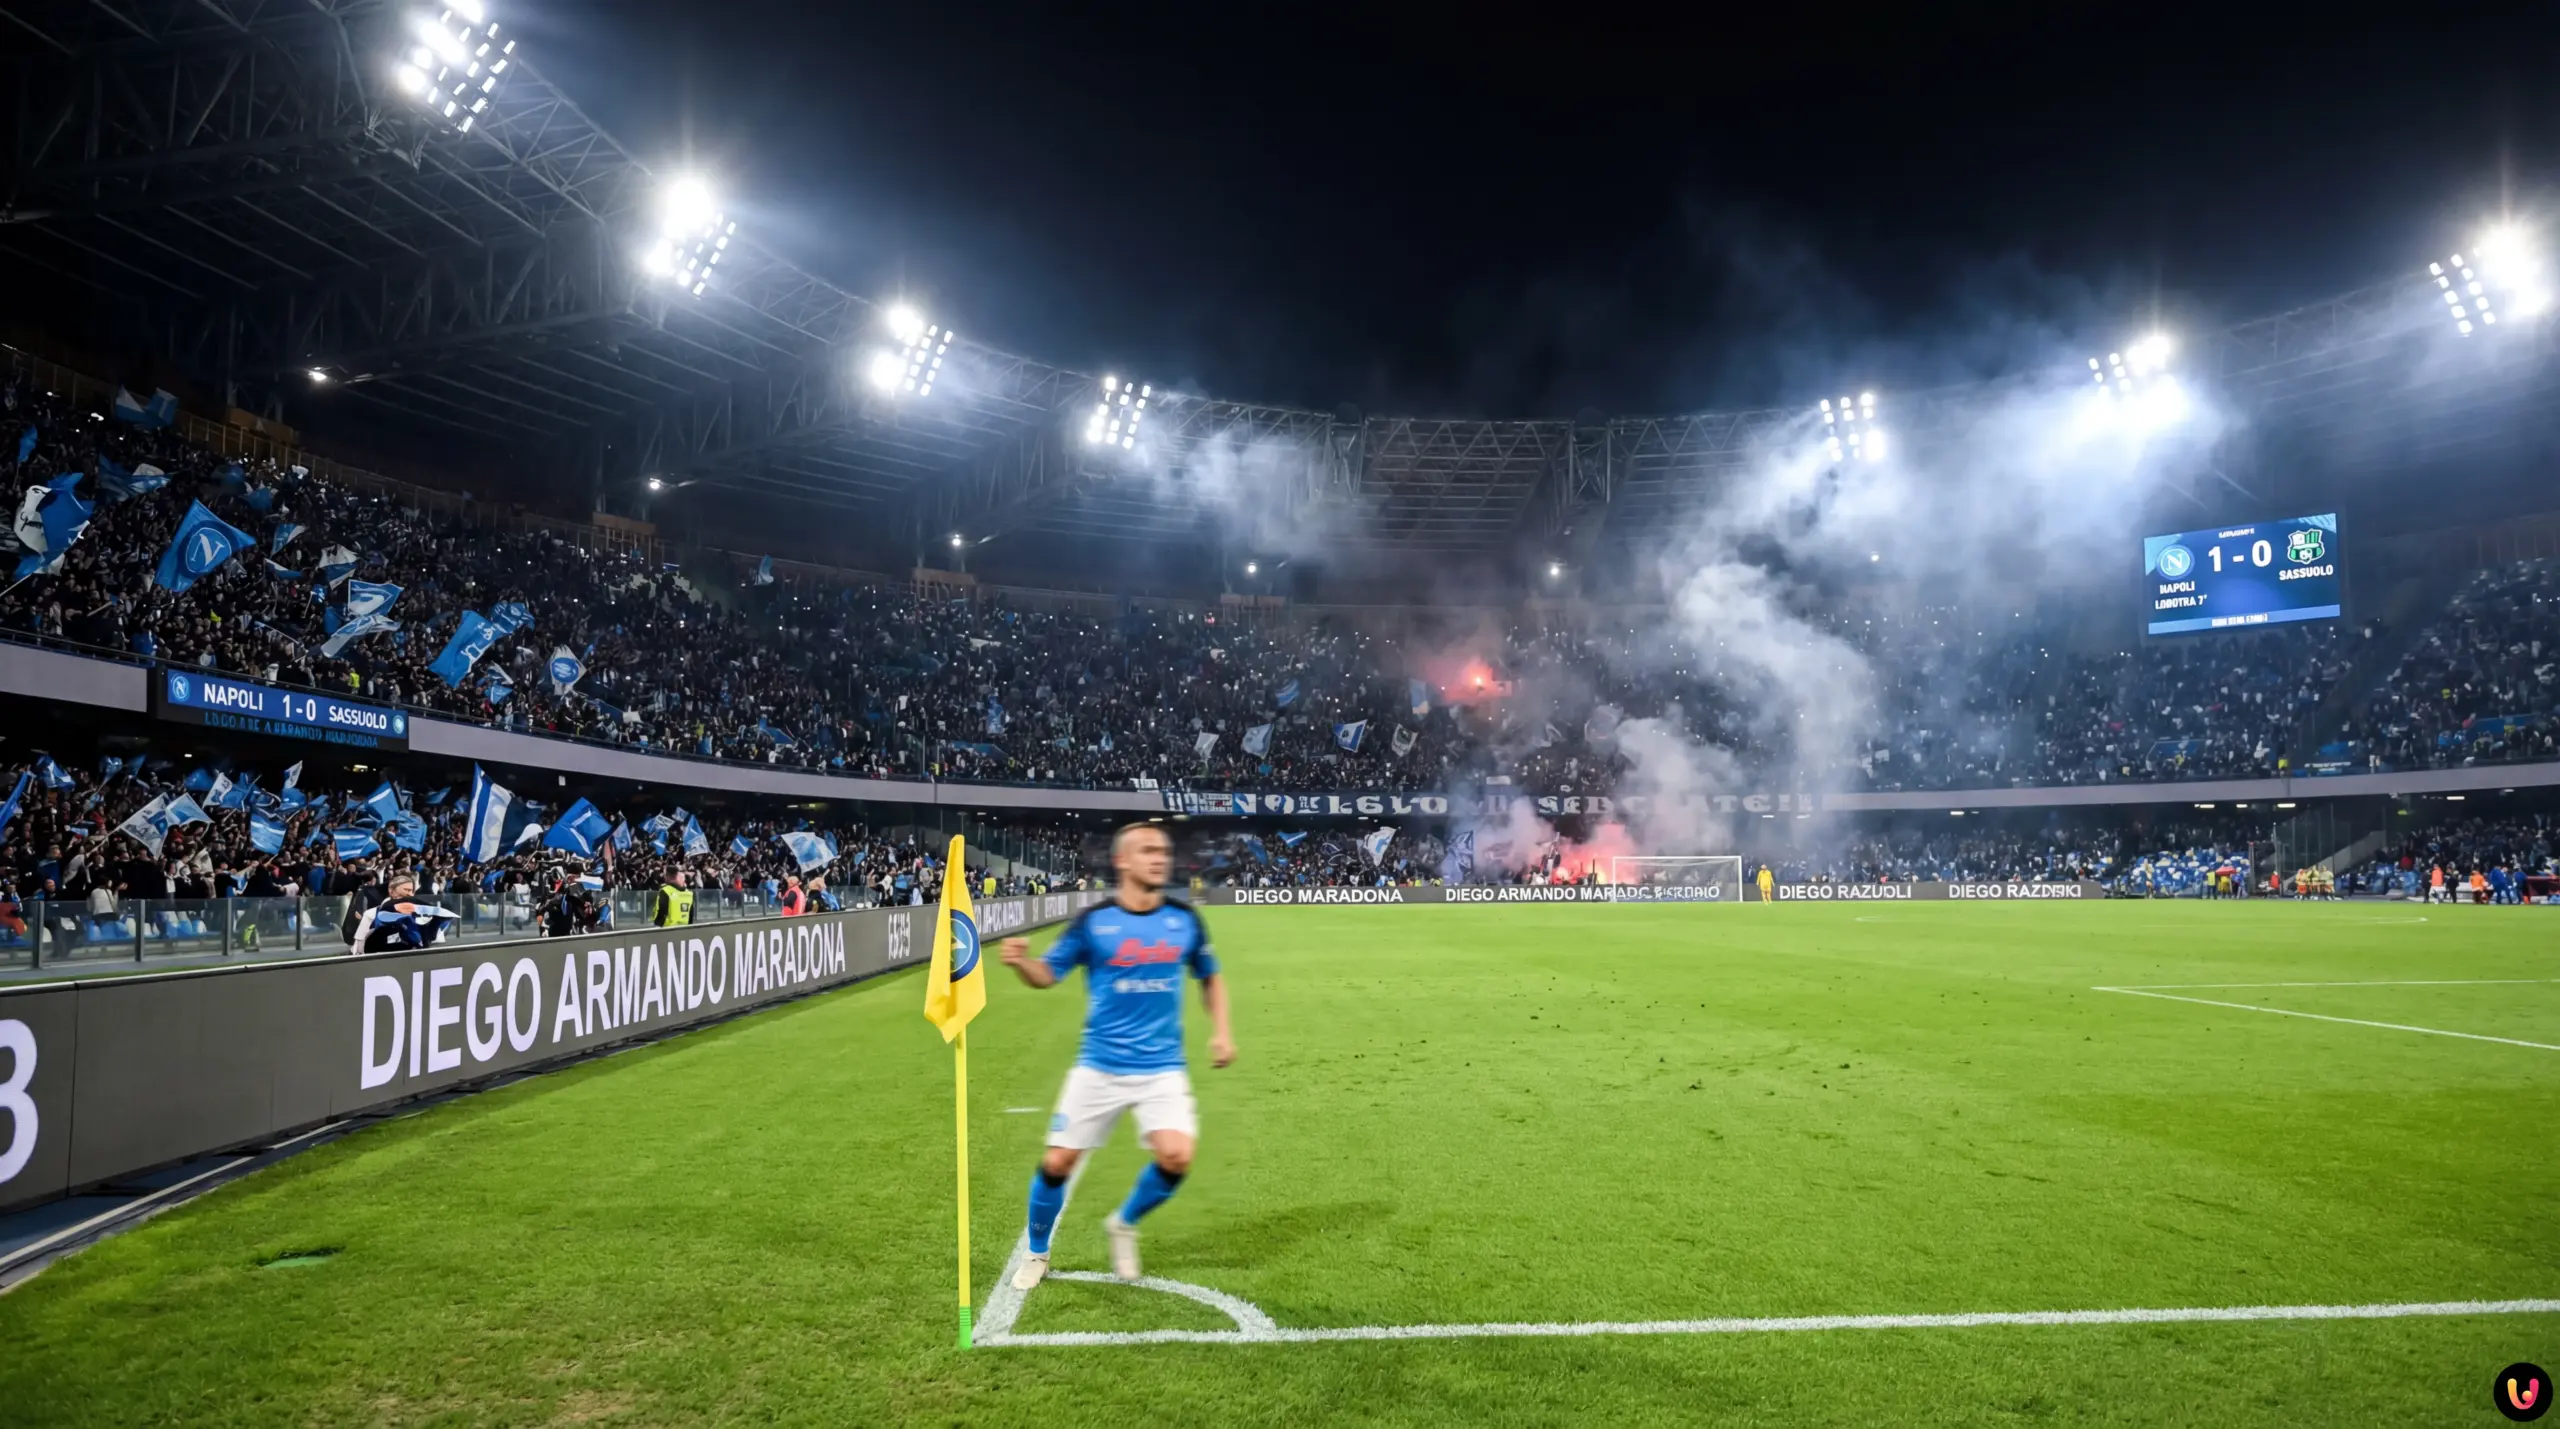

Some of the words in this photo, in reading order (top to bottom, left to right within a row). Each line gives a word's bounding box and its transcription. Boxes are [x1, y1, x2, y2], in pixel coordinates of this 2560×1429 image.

[2279, 564, 2334, 581] SASSUOLO
[2159, 580, 2196, 595] NAPOLI
[203, 682, 264, 711] NAPOLI
[328, 705, 387, 730] SASSUOLO
[1234, 889, 1293, 904] DIEGO
[1297, 888, 1404, 903] MARADONA
[1445, 887, 1495, 902] DIEGO
[1497, 887, 1577, 901] ARMANDO
[1779, 885, 1833, 899] DIEGO
[1948, 884, 2002, 899] DIEGO
[359, 957, 542, 1090] DIEGO
[552, 935, 727, 1043] ARMANDO
[733, 921, 846, 999] MARADONA
